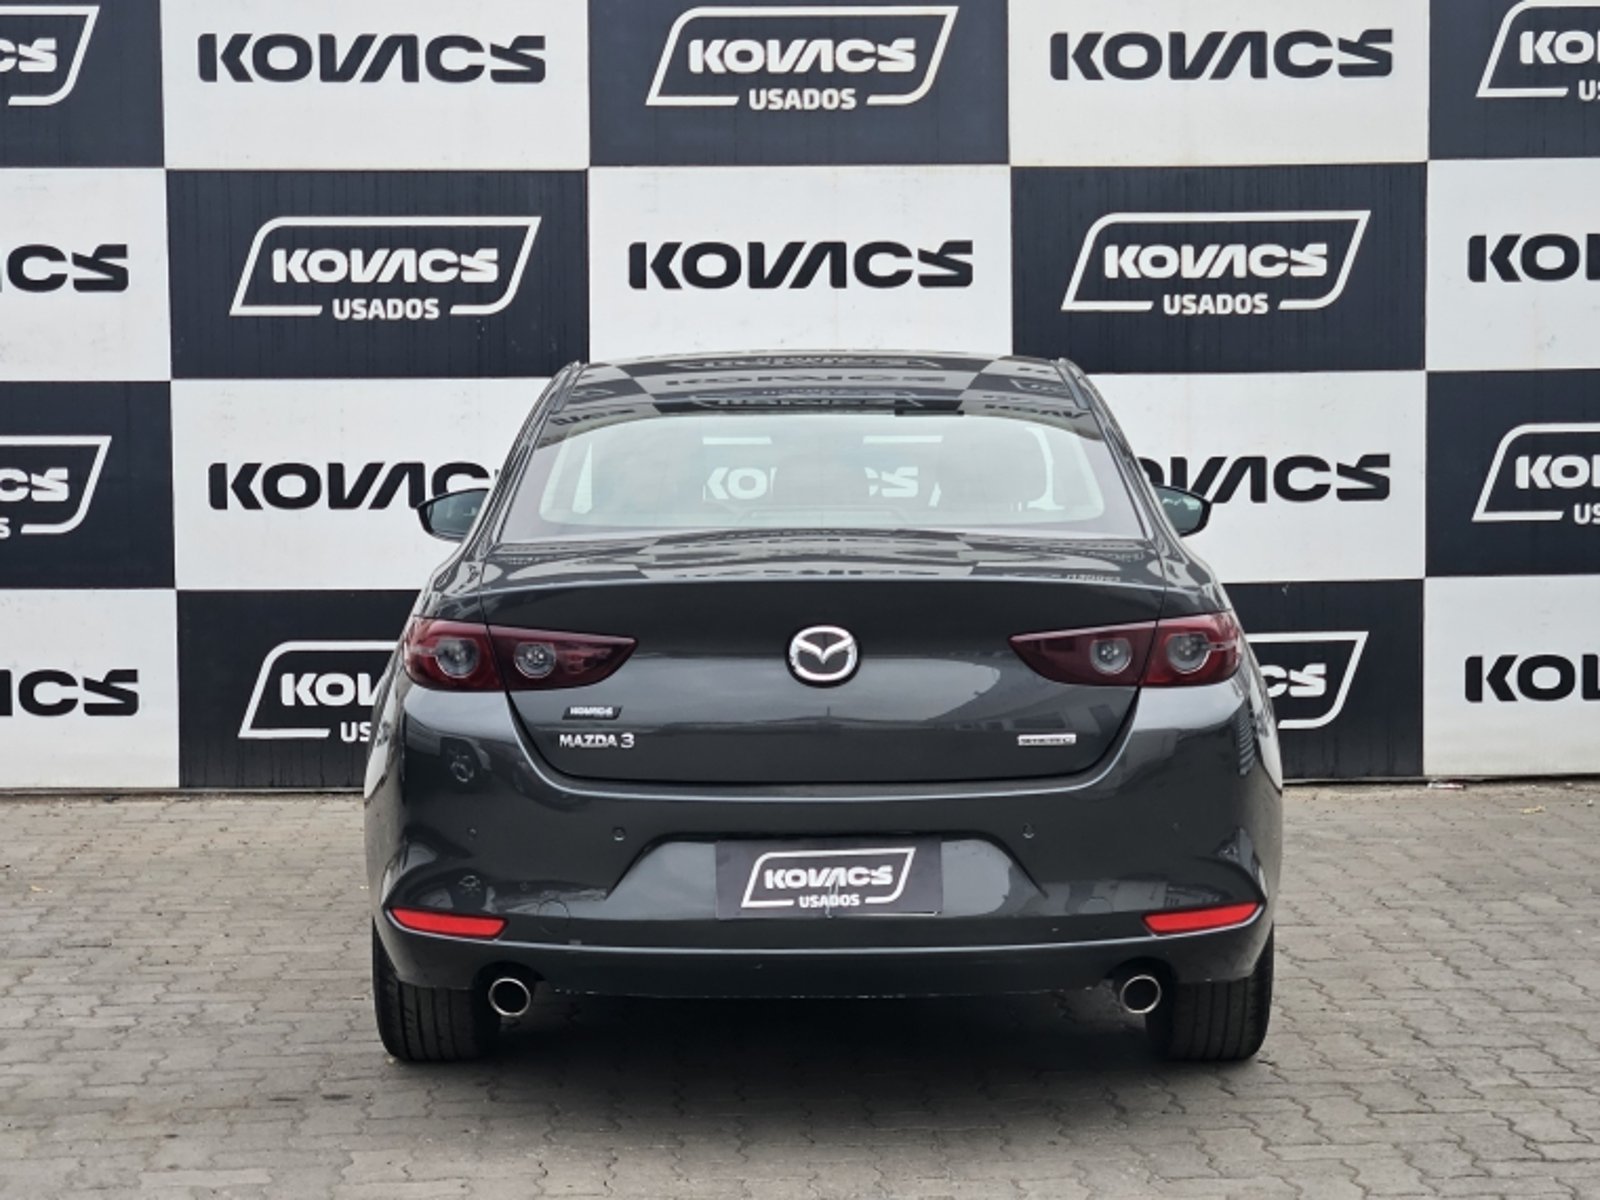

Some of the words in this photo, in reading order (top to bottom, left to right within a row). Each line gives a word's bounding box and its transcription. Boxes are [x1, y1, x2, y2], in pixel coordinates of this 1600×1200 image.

[198, 34, 545, 83] KOVACS
[688, 38, 916, 74] KOVACS
[1051, 29, 1392, 80] KOVACS
[1520, 31, 1600, 64] KO
[749, 88, 856, 110] USADOS
[1579, 80, 1600, 100] U
[0, 244, 128, 292] CS
[272, 248, 498, 283] KOVACS
[629, 241, 973, 289] KOVACS
[1104, 243, 1327, 279] KOVACS
[1468, 234, 1600, 282] KO
[333, 298, 439, 320] USADOS
[1164, 293, 1268, 314] USADOS
[208, 462, 494, 510] KOVAC
[1516, 455, 1600, 488] KO
[0, 669, 139, 716] CS
[560, 733, 618, 749] MAZDA
[620, 732, 635, 748] 3
[763, 864, 894, 889] KOVACS
[798, 893, 861, 909] USADOS
